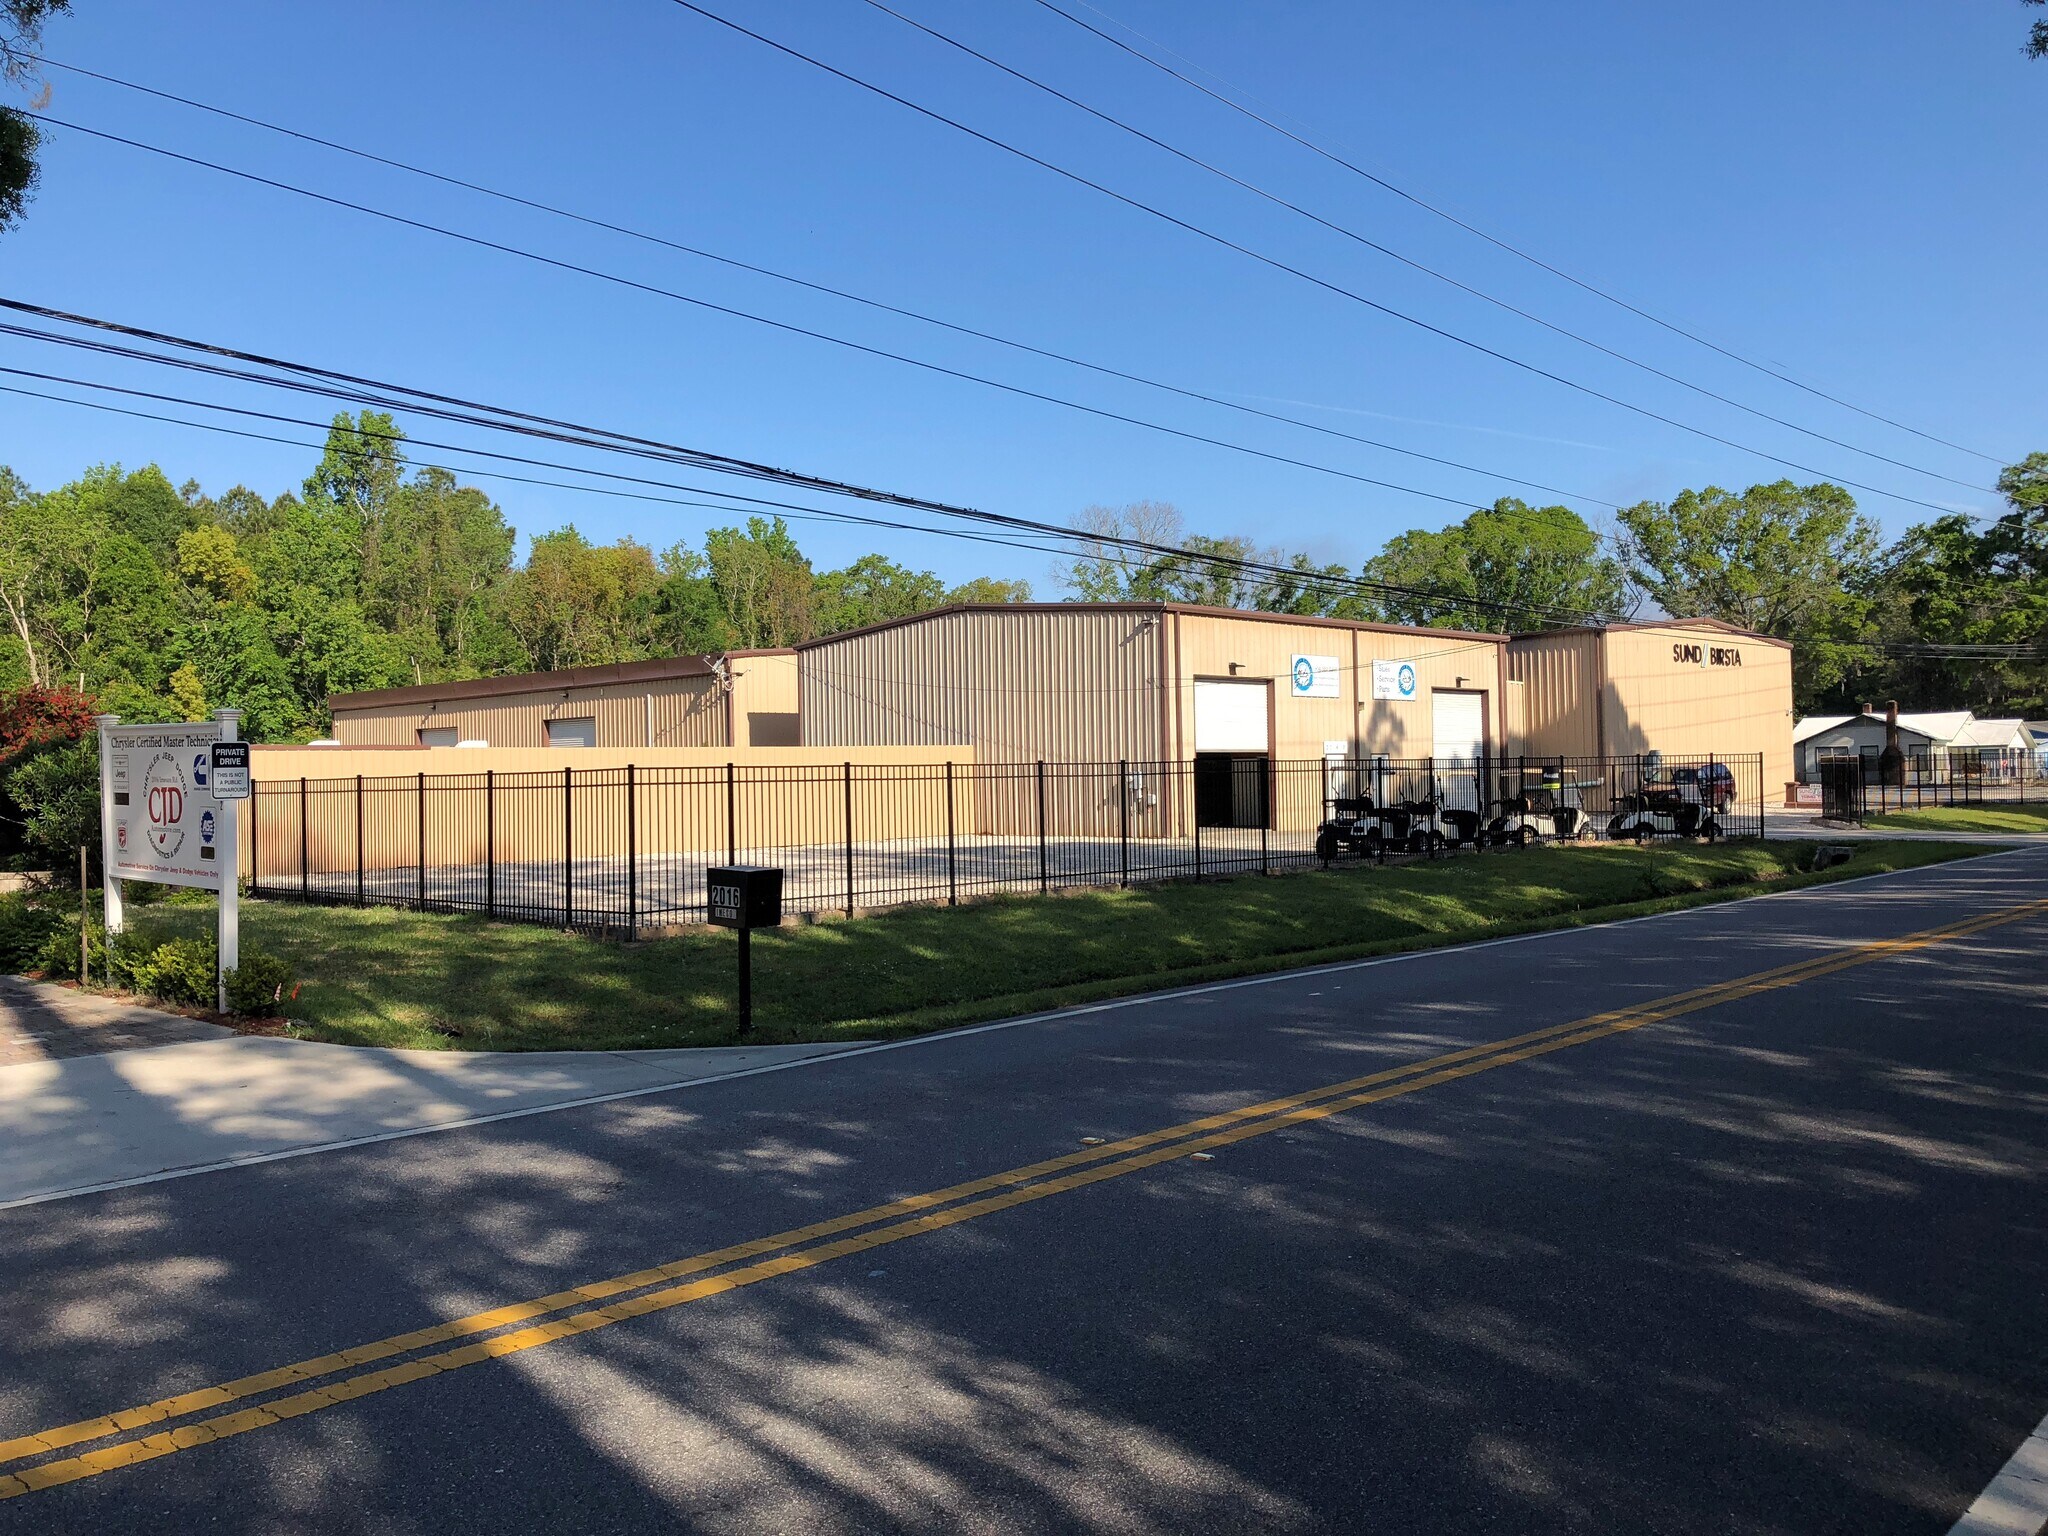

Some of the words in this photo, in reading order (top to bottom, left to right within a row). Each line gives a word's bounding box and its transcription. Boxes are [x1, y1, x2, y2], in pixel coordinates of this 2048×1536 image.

[1673, 643, 1702, 663] SUND
[1710, 647, 1742, 667] BIRSTA
[111, 736, 135, 750] Chrysler
[137, 735, 162, 748] Certified
[163, 735, 184, 748] Master
[215, 748, 245, 756] PRIVATE
[219, 757, 241, 765] DRIVE
[143, 754, 160, 798] CHRYSLER
[162, 752, 174, 763] JEEP
[175, 763, 189, 799] DODGE
[136, 862, 149, 870] Service
[154, 864, 170, 873] Chrysler
[170, 866, 179, 874] Jeep
[182, 867, 194, 876] Dodge
[210, 870, 219, 879] Only
[712, 887, 739, 907] 2016
